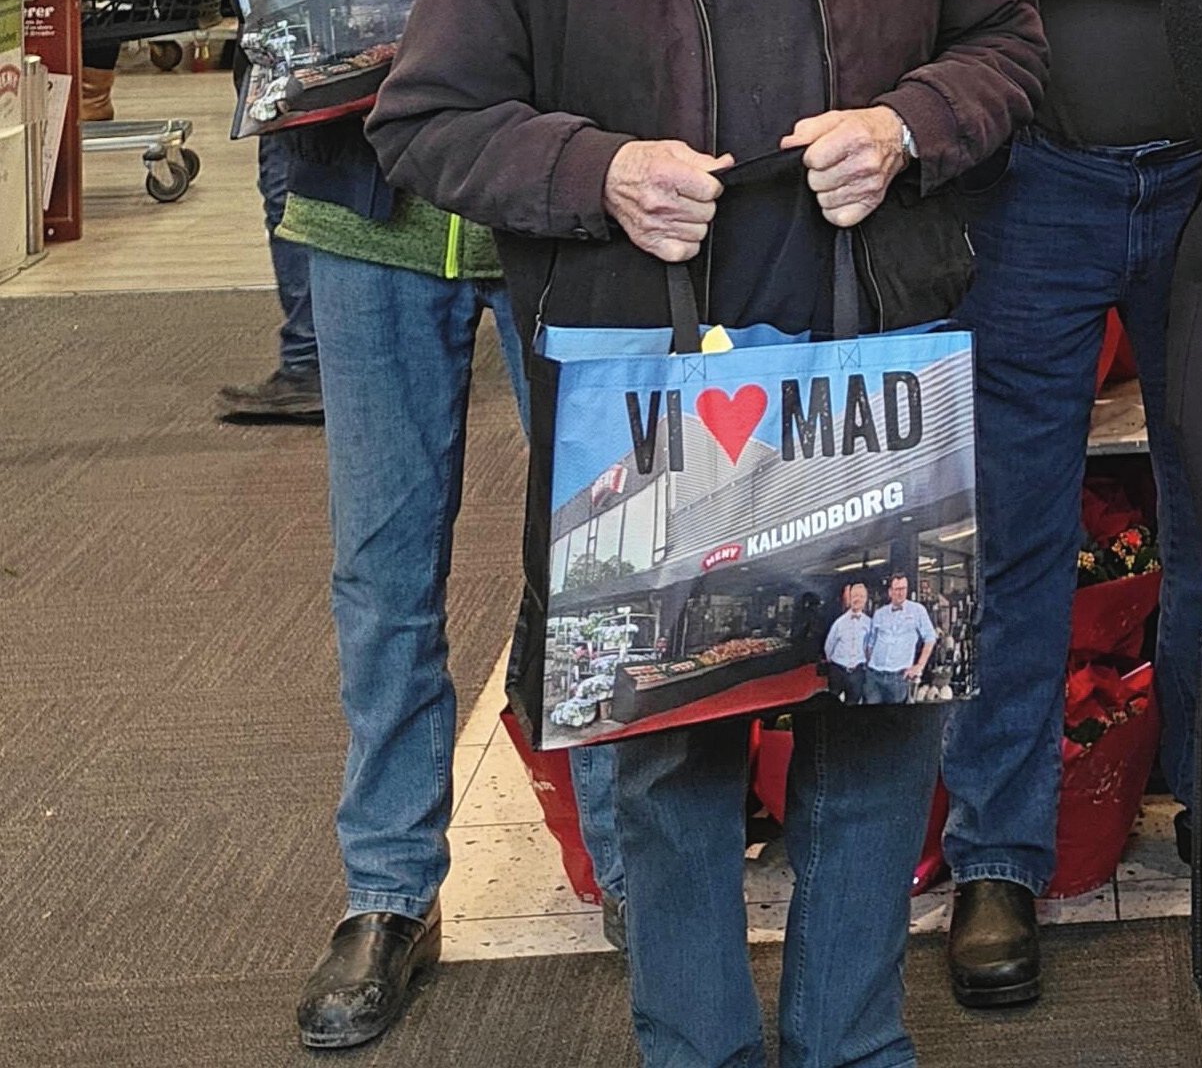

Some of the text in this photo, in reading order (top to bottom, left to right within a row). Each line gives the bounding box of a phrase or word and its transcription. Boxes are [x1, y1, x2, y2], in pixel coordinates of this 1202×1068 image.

[625, 370, 924, 475] VI MAD
[704, 481, 904, 569] MENY KALUNDBORG
